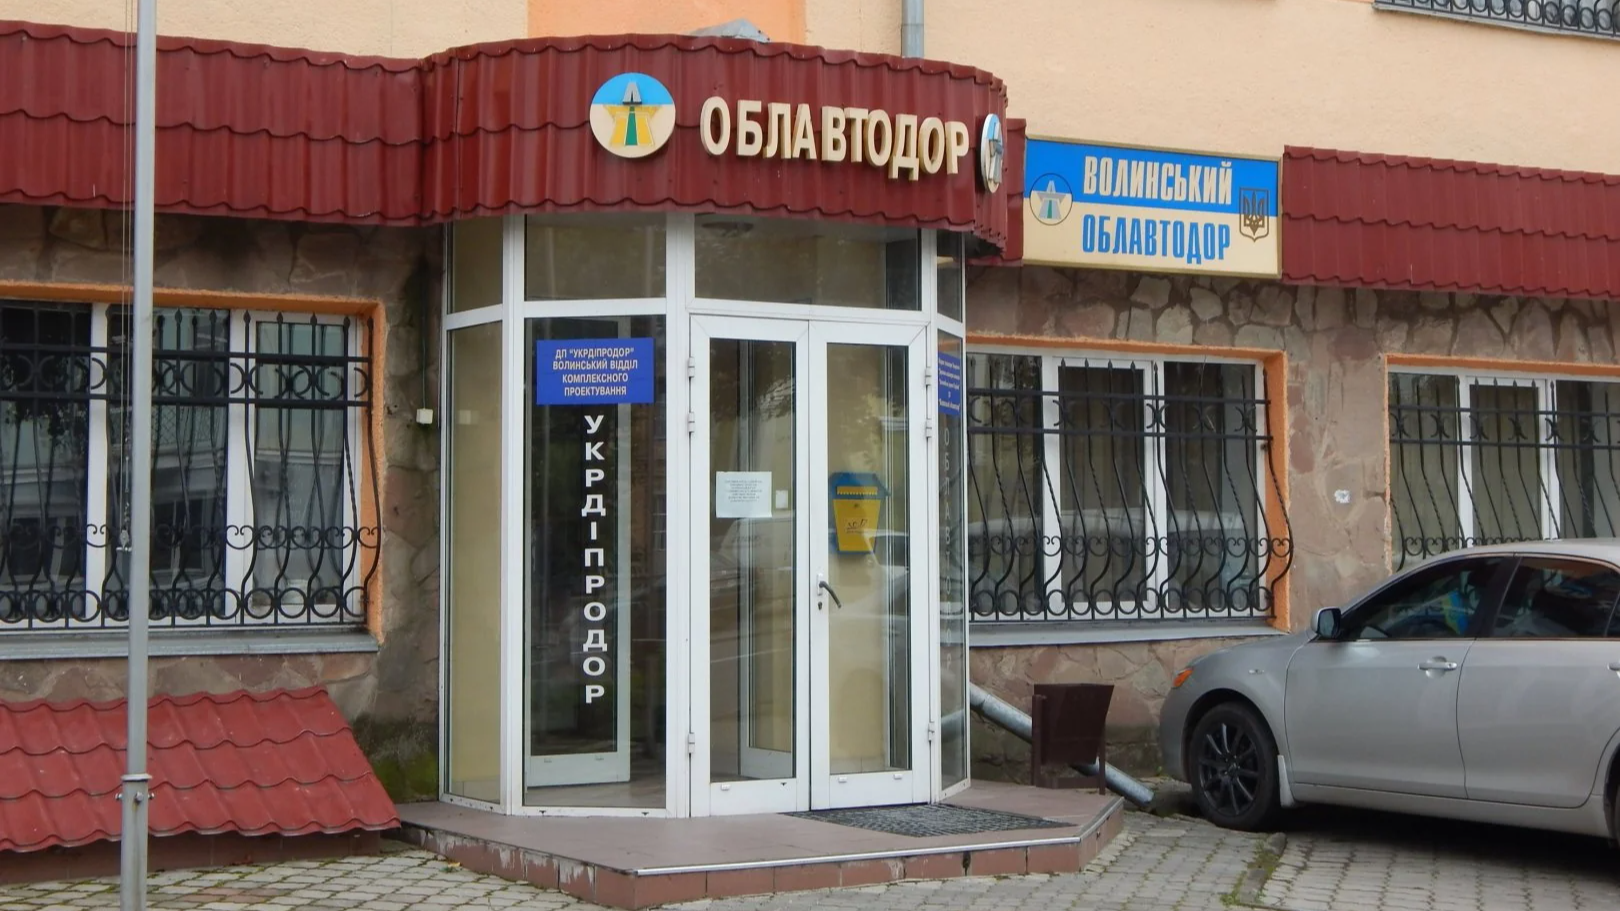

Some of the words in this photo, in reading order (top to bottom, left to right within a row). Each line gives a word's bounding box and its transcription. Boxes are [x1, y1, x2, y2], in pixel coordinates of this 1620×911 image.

[700, 96, 970, 181] ОБЛАВТОДОР
[1083, 155, 1233, 205] ВОЛИНСЬКИЙ
[1082, 214, 1231, 265] ОБЛАВТОДОР
[552, 359, 608, 371] ВОЛИНСЬКИЙ
[610, 359, 638, 372] ВІДДІЛ
[555, 349, 567, 360] ДП
[562, 373, 629, 384] КОМПЛЕКСНОГО
[564, 386, 627, 397] ПРОЕКТУВАННЯ
[581, 415, 608, 704] УКРДІПРОДОР
